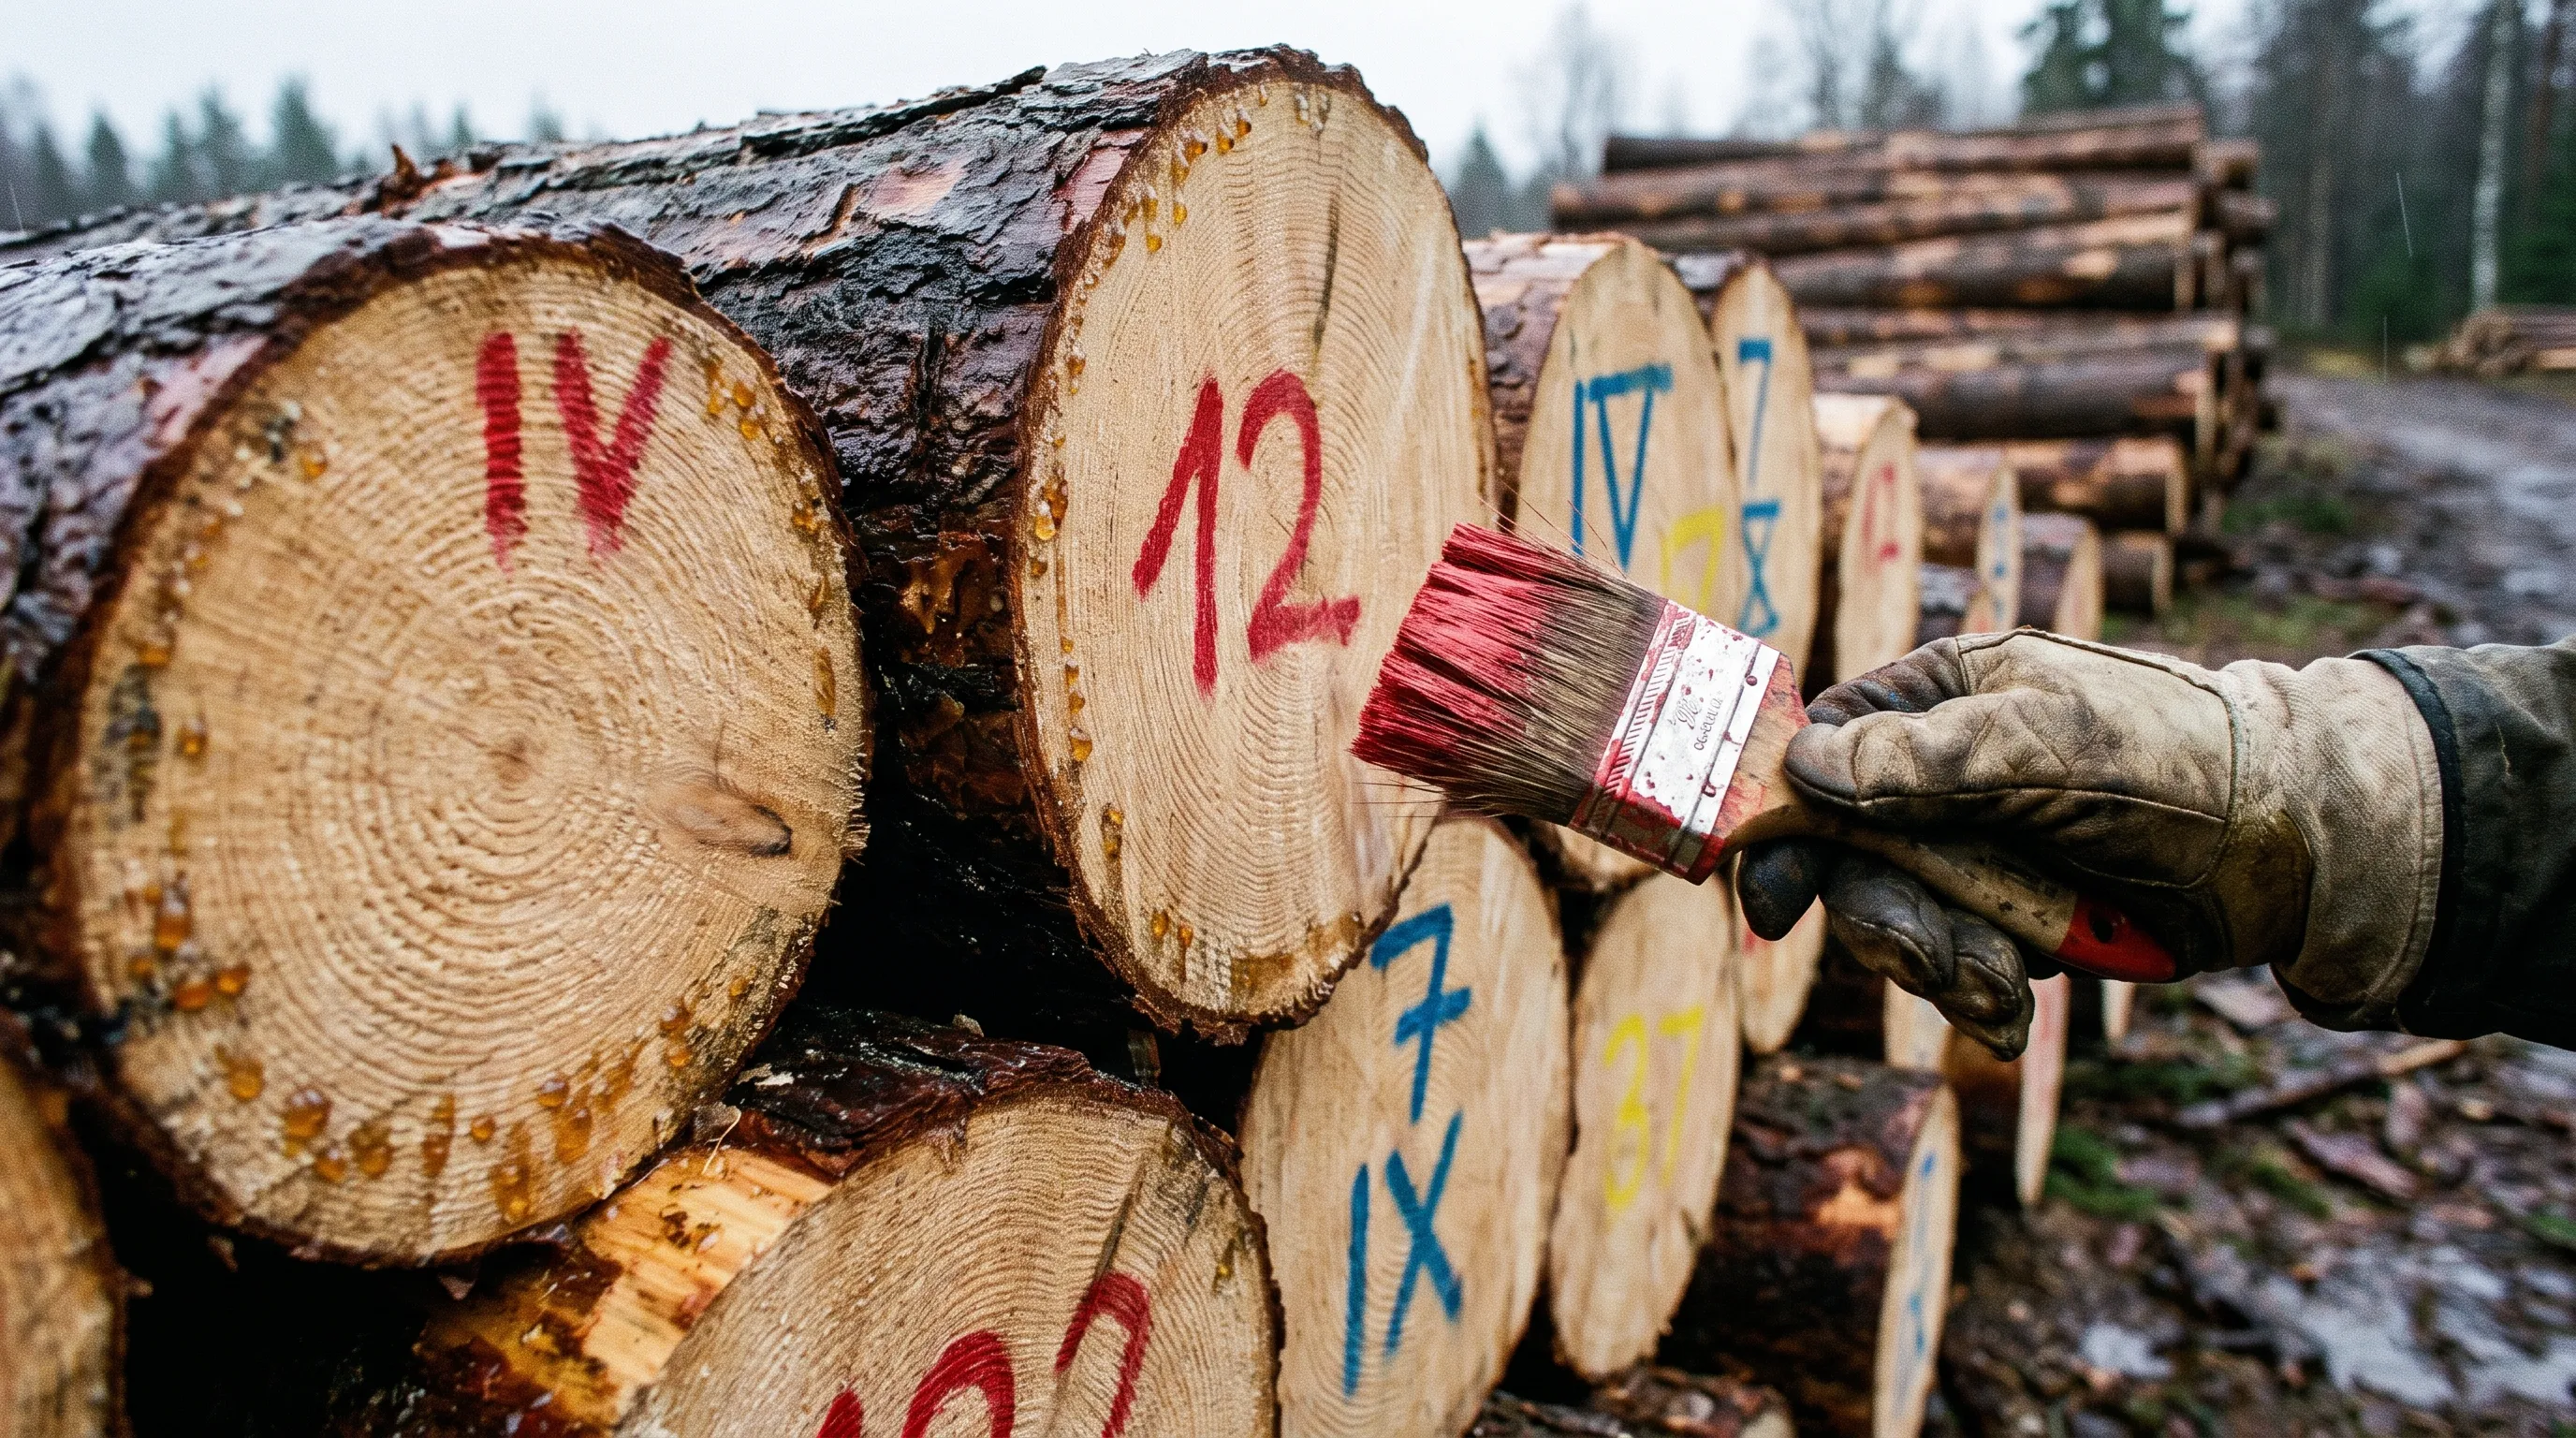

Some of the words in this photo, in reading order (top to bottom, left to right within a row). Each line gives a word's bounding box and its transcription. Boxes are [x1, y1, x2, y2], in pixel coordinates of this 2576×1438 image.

[476, 328, 673, 575] IV
[1132, 368, 1363, 697] 12
[1370, 902, 1471, 1123] 7
[1603, 1002, 1705, 1214] 37
[1343, 1110, 1464, 1396] IX
